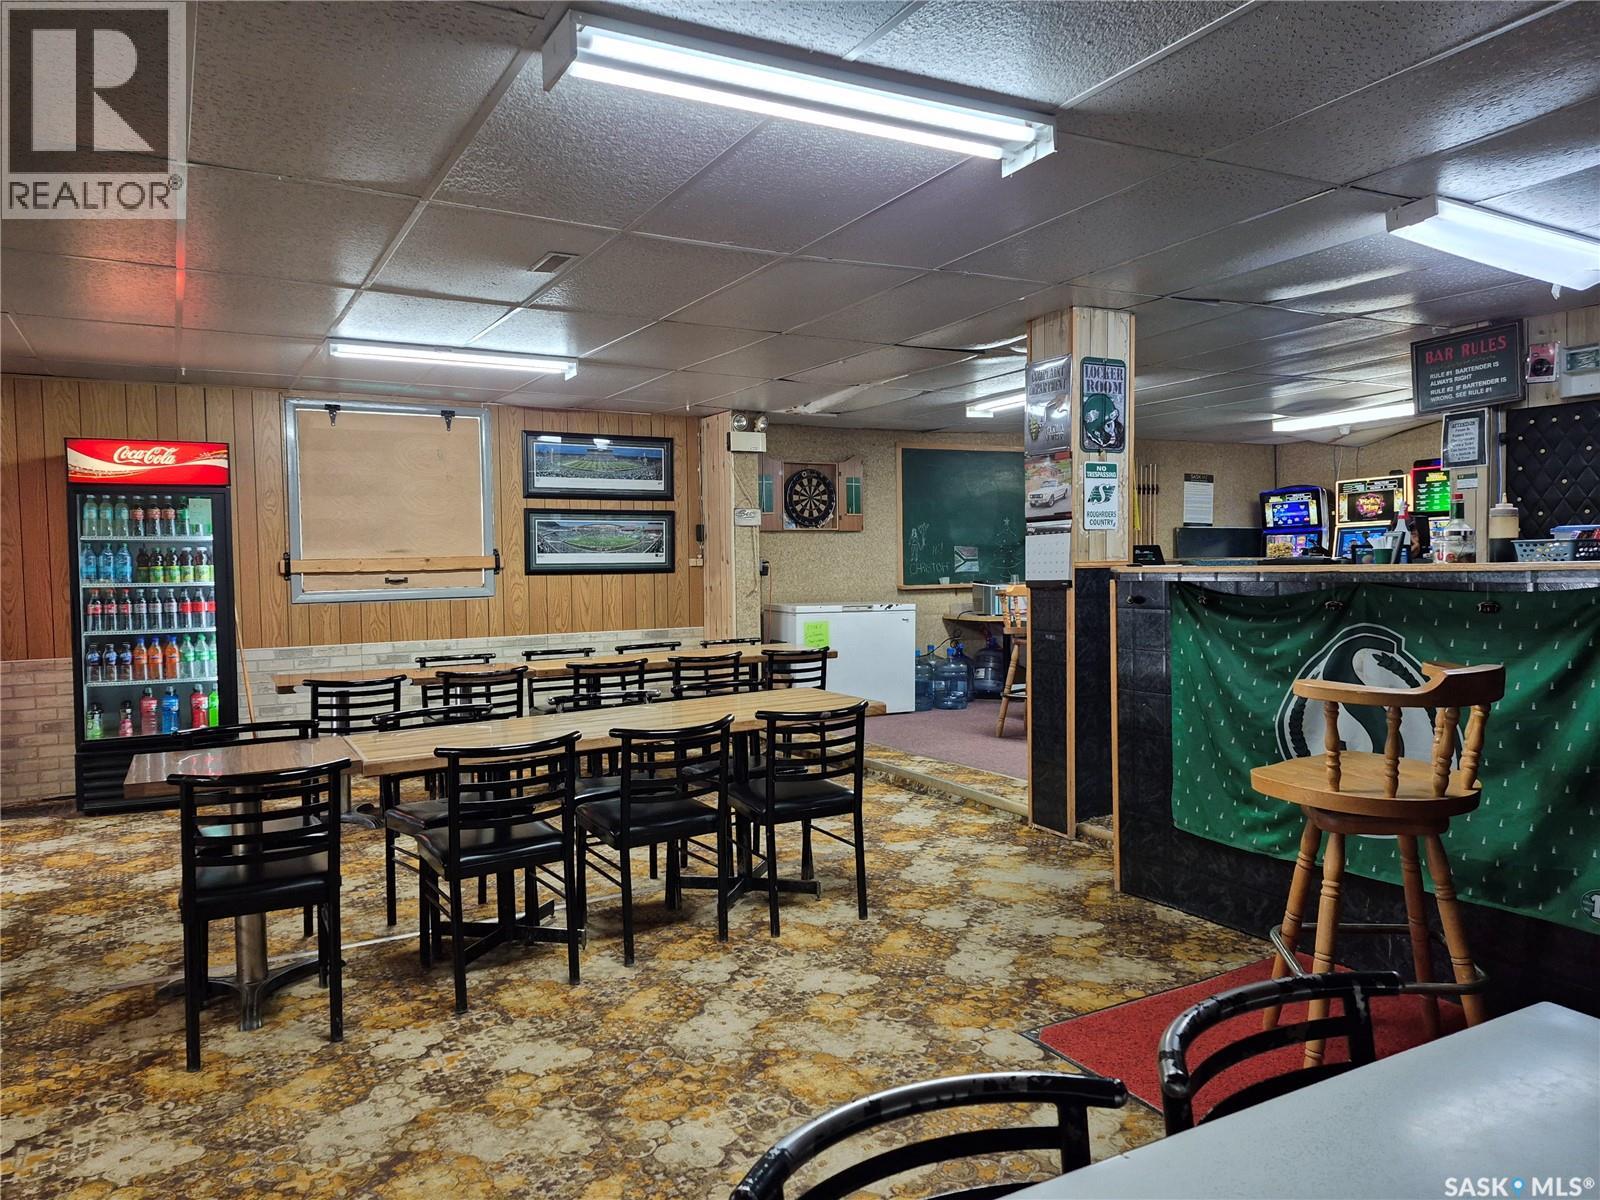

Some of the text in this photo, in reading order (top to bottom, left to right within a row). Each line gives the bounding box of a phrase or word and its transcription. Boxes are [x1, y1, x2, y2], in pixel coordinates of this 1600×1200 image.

[1425, 347, 1454, 365] BAR
[1461, 335, 1508, 357] RULES
[1084, 364, 1124, 381] LOCKER
[1430, 372, 1445, 380] RULE
[1445, 370, 1453, 378] #1
[1455, 362, 1492, 375] BARTENDER
[1086, 379, 1123, 394] ROOM
[1430, 373, 1473, 387] ALWAYS RIGHT
[1430, 387, 1446, 396] RULE
[1455, 383, 1462, 391] IF
[1462, 379, 1500, 390] BARTENDER
[1455, 390, 1467, 399] SEE
[1468, 388, 1484, 397] RULE
[1485, 386, 1493, 394] #1
[1086, 510, 1117, 518] ROUGHRIDERS
[1089, 518, 1114, 527] COUNTRY
